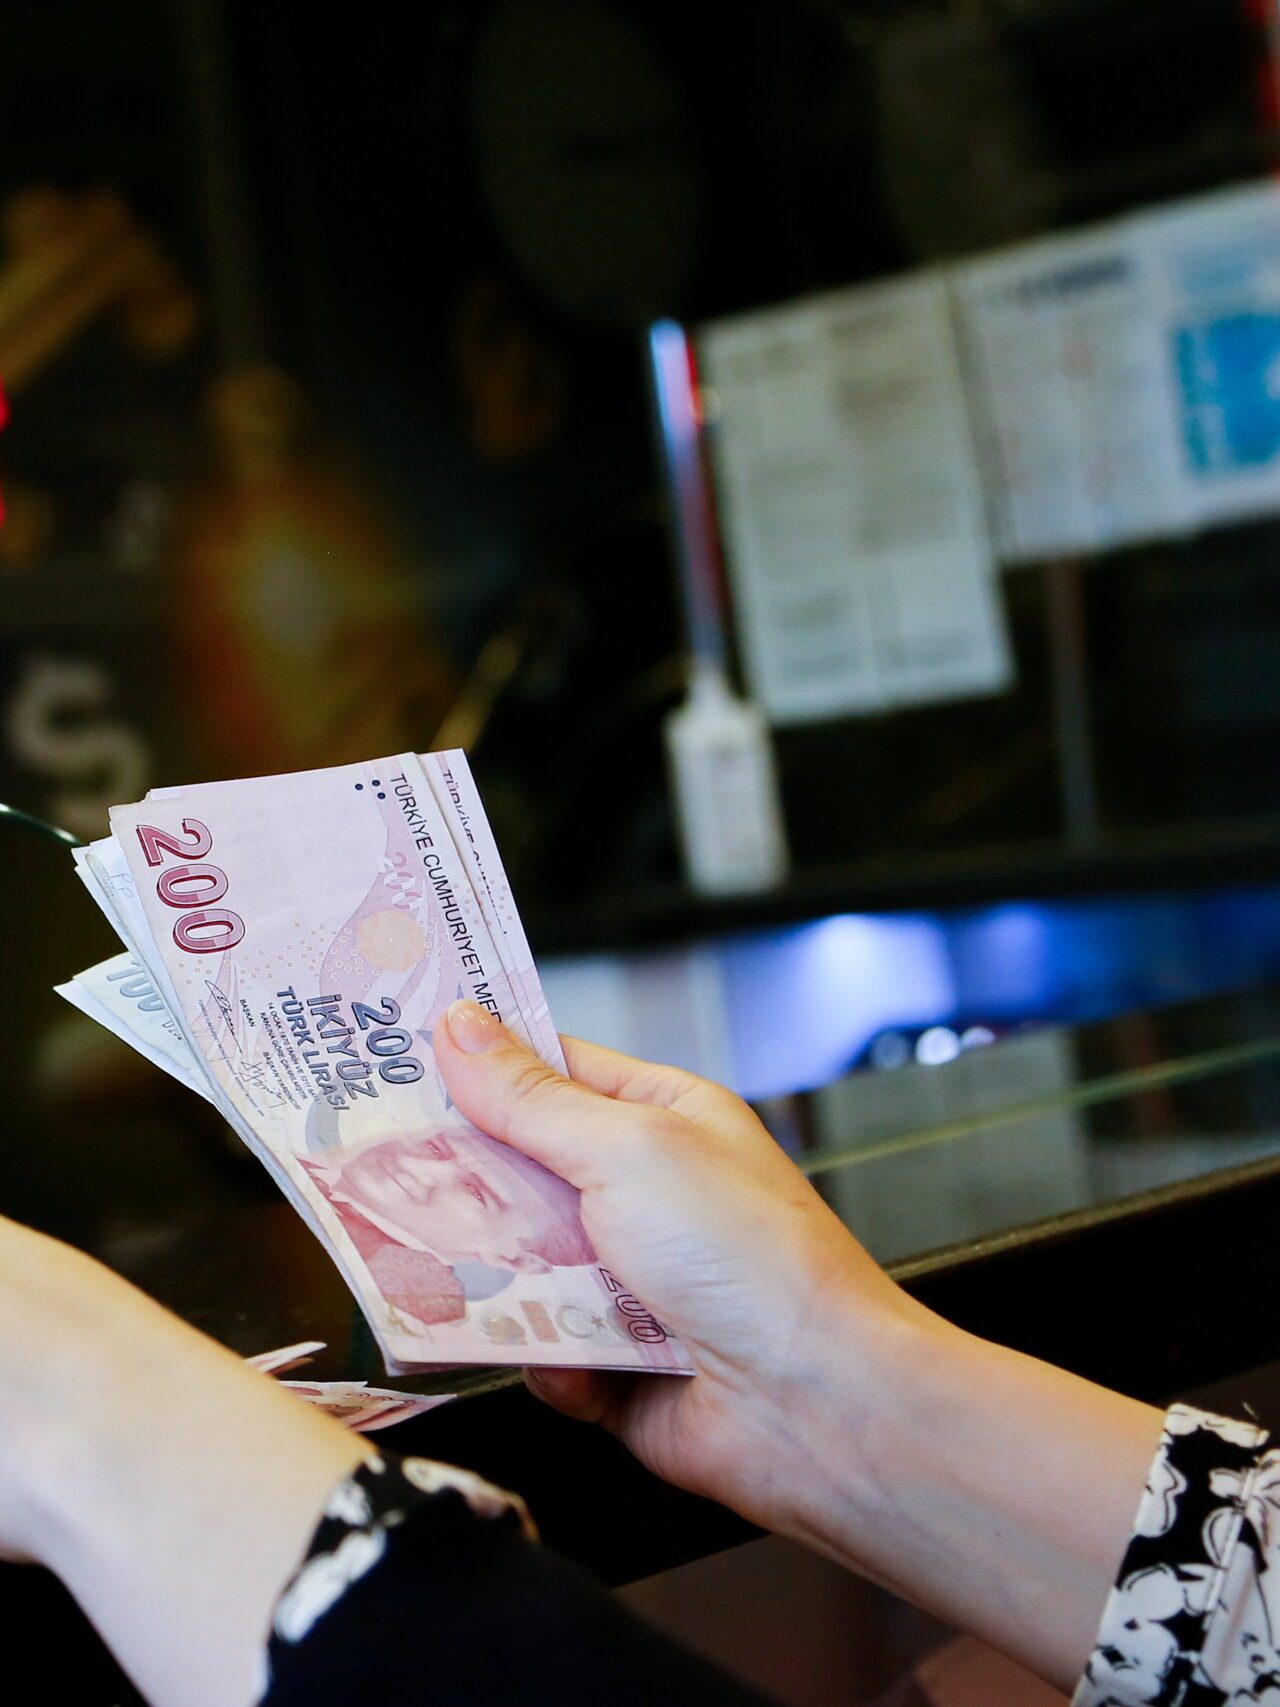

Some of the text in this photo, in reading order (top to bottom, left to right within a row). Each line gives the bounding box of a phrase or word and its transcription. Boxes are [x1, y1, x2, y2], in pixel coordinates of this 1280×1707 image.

[135, 818, 245, 954] 200
[390, 773, 434, 850] TÜRKİYE
[423, 854, 485, 977] CUMHURİYET
[239, 997, 256, 1027] BAŞKAN
[270, 1010, 283, 1030] OCAK
[277, 985, 350, 1110] TÜRK LİRASI
[307, 994, 379, 1100] İKİYÜZ
[351, 996, 425, 1084] 200
